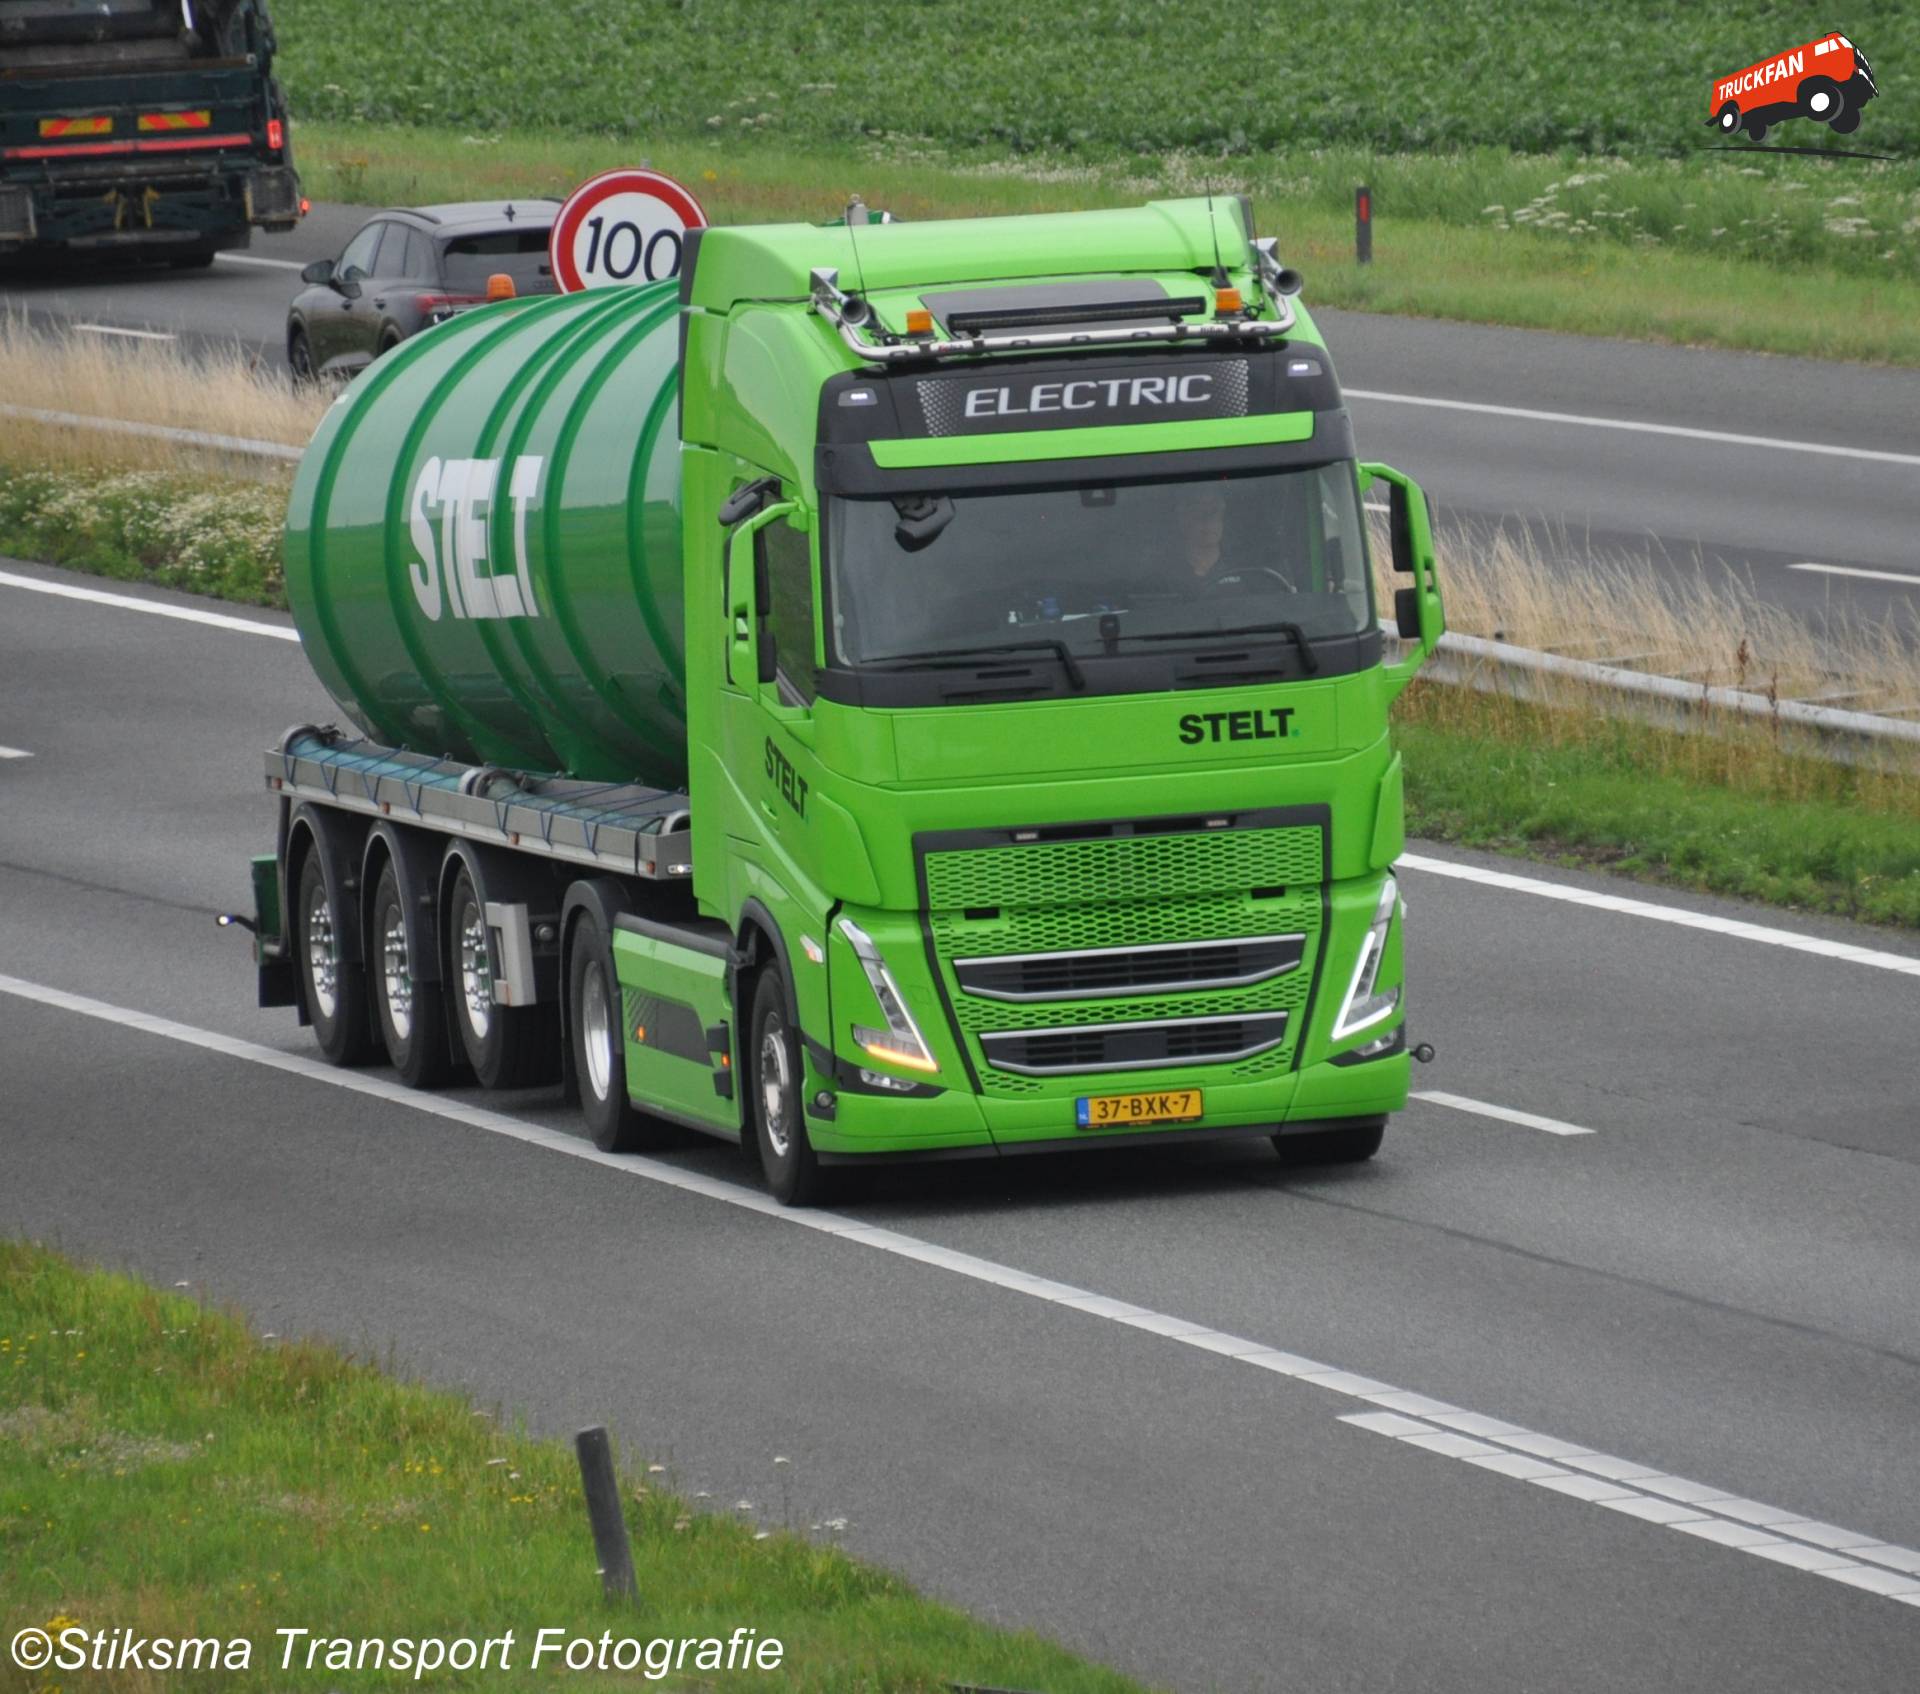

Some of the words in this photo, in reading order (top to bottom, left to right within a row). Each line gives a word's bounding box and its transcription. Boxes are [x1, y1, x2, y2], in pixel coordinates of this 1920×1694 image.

[585, 216, 682, 281] 100
[964, 374, 1213, 417] ELECTRIC
[1096, 1094, 1192, 1120] 37-BXK-7
